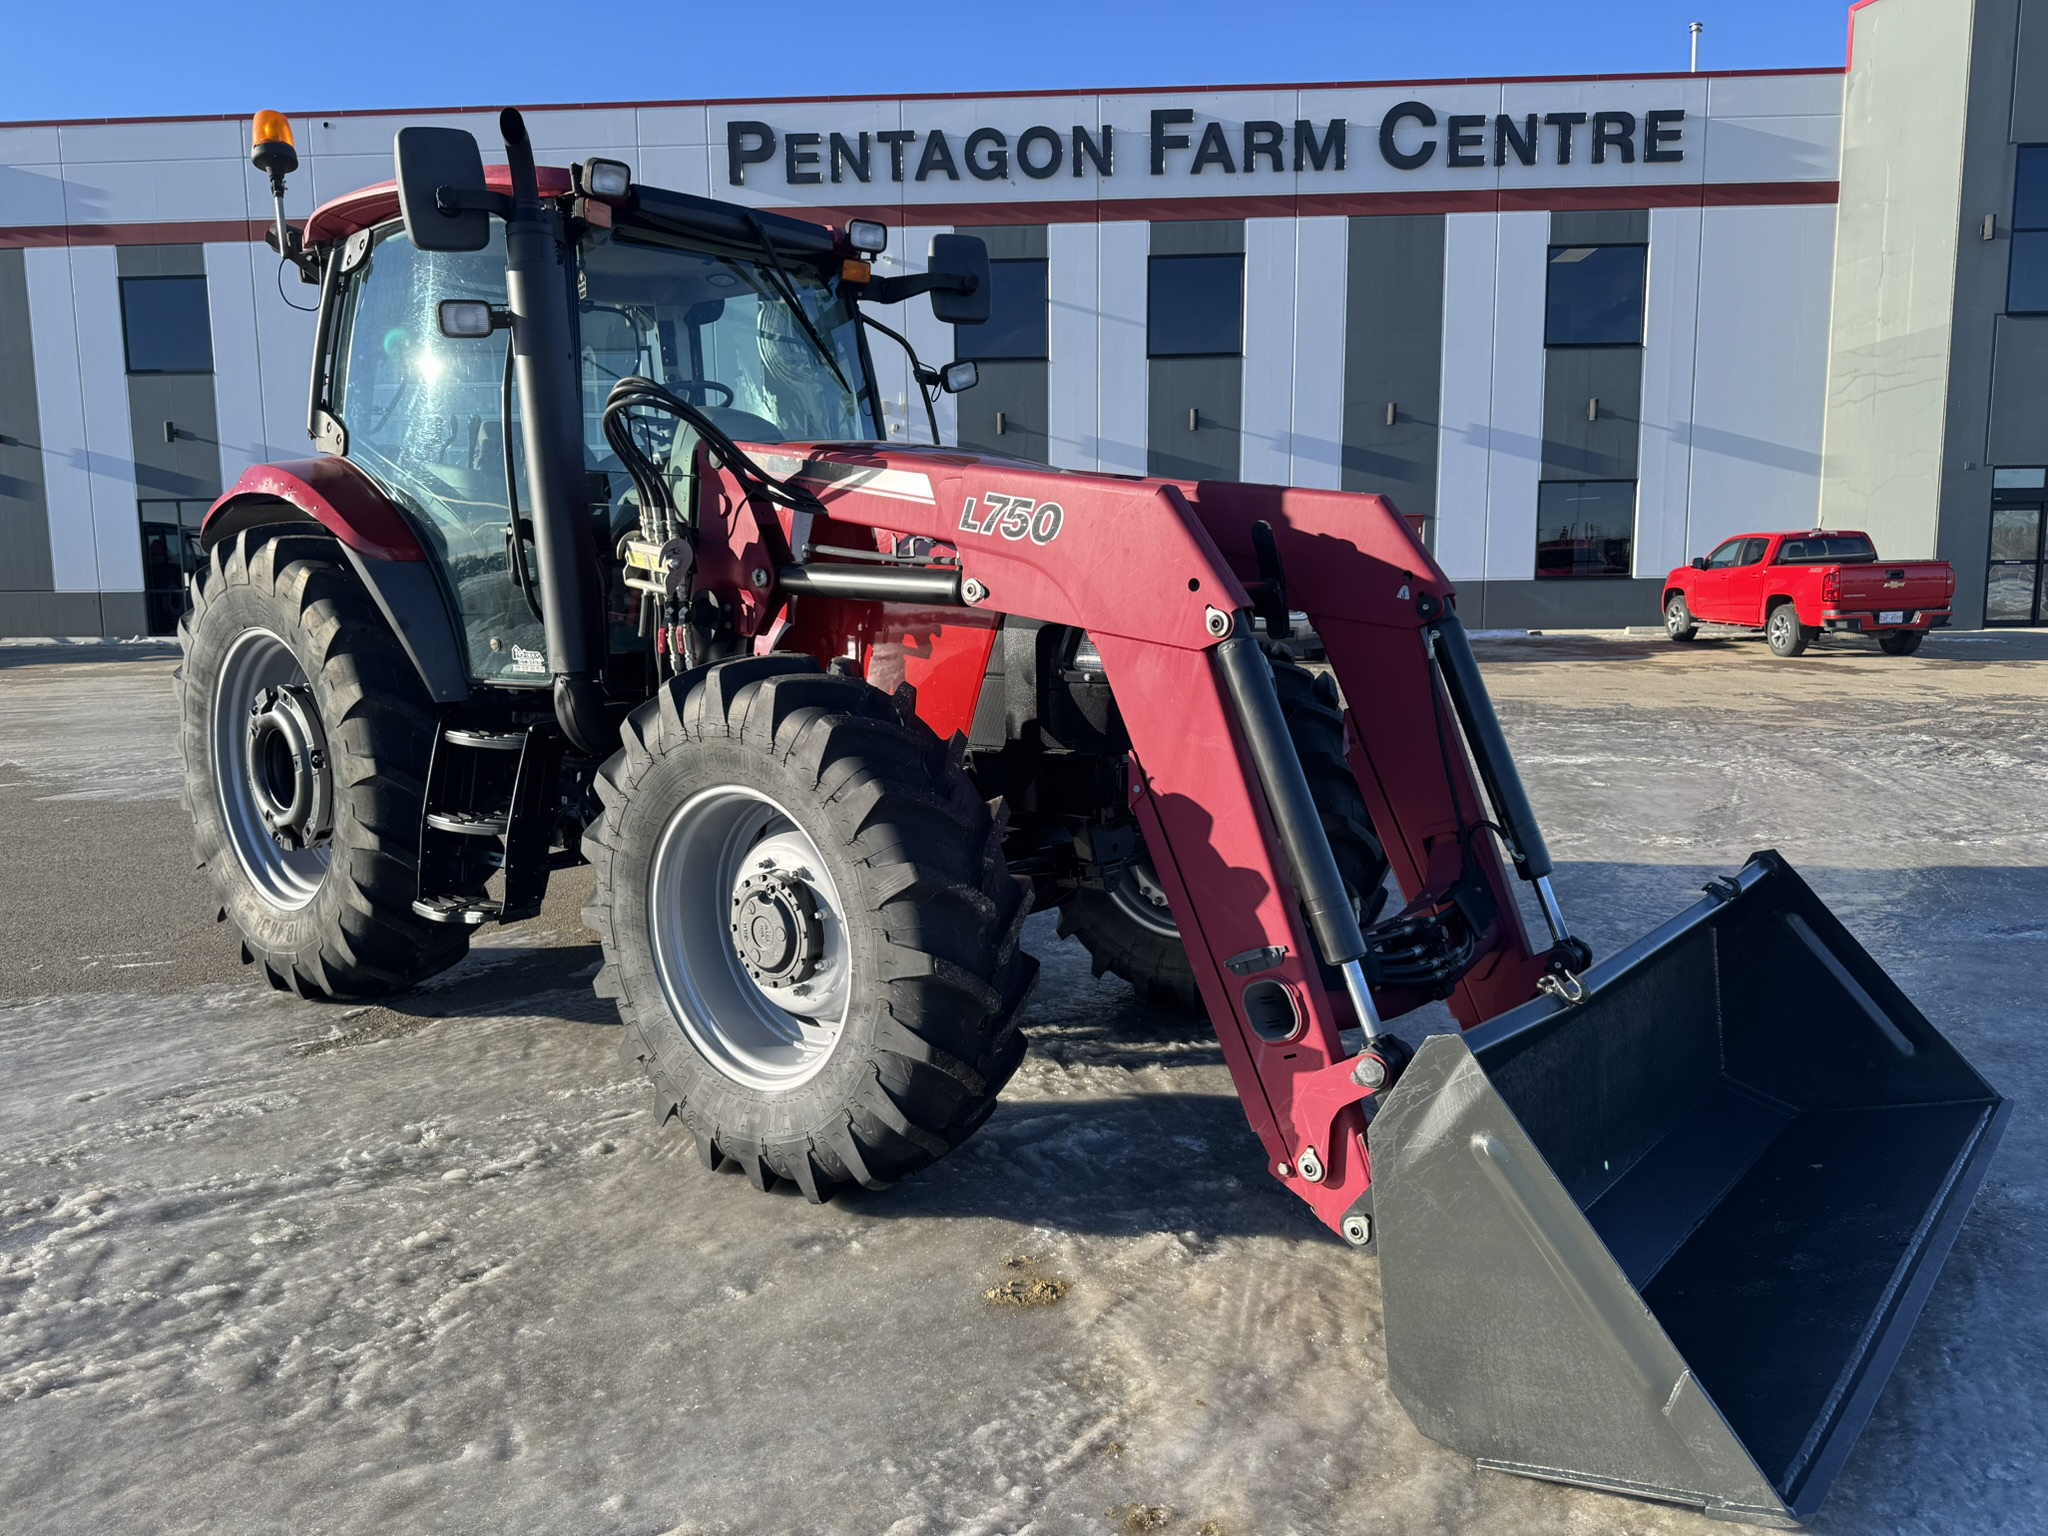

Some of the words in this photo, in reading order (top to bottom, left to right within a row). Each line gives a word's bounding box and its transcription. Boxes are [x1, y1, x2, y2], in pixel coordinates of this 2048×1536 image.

[727, 121, 1114, 186] PENTAGON
[1149, 108, 1348, 175] FARM
[1378, 101, 1686, 171] CENTRE
[958, 491, 1064, 545] L750
